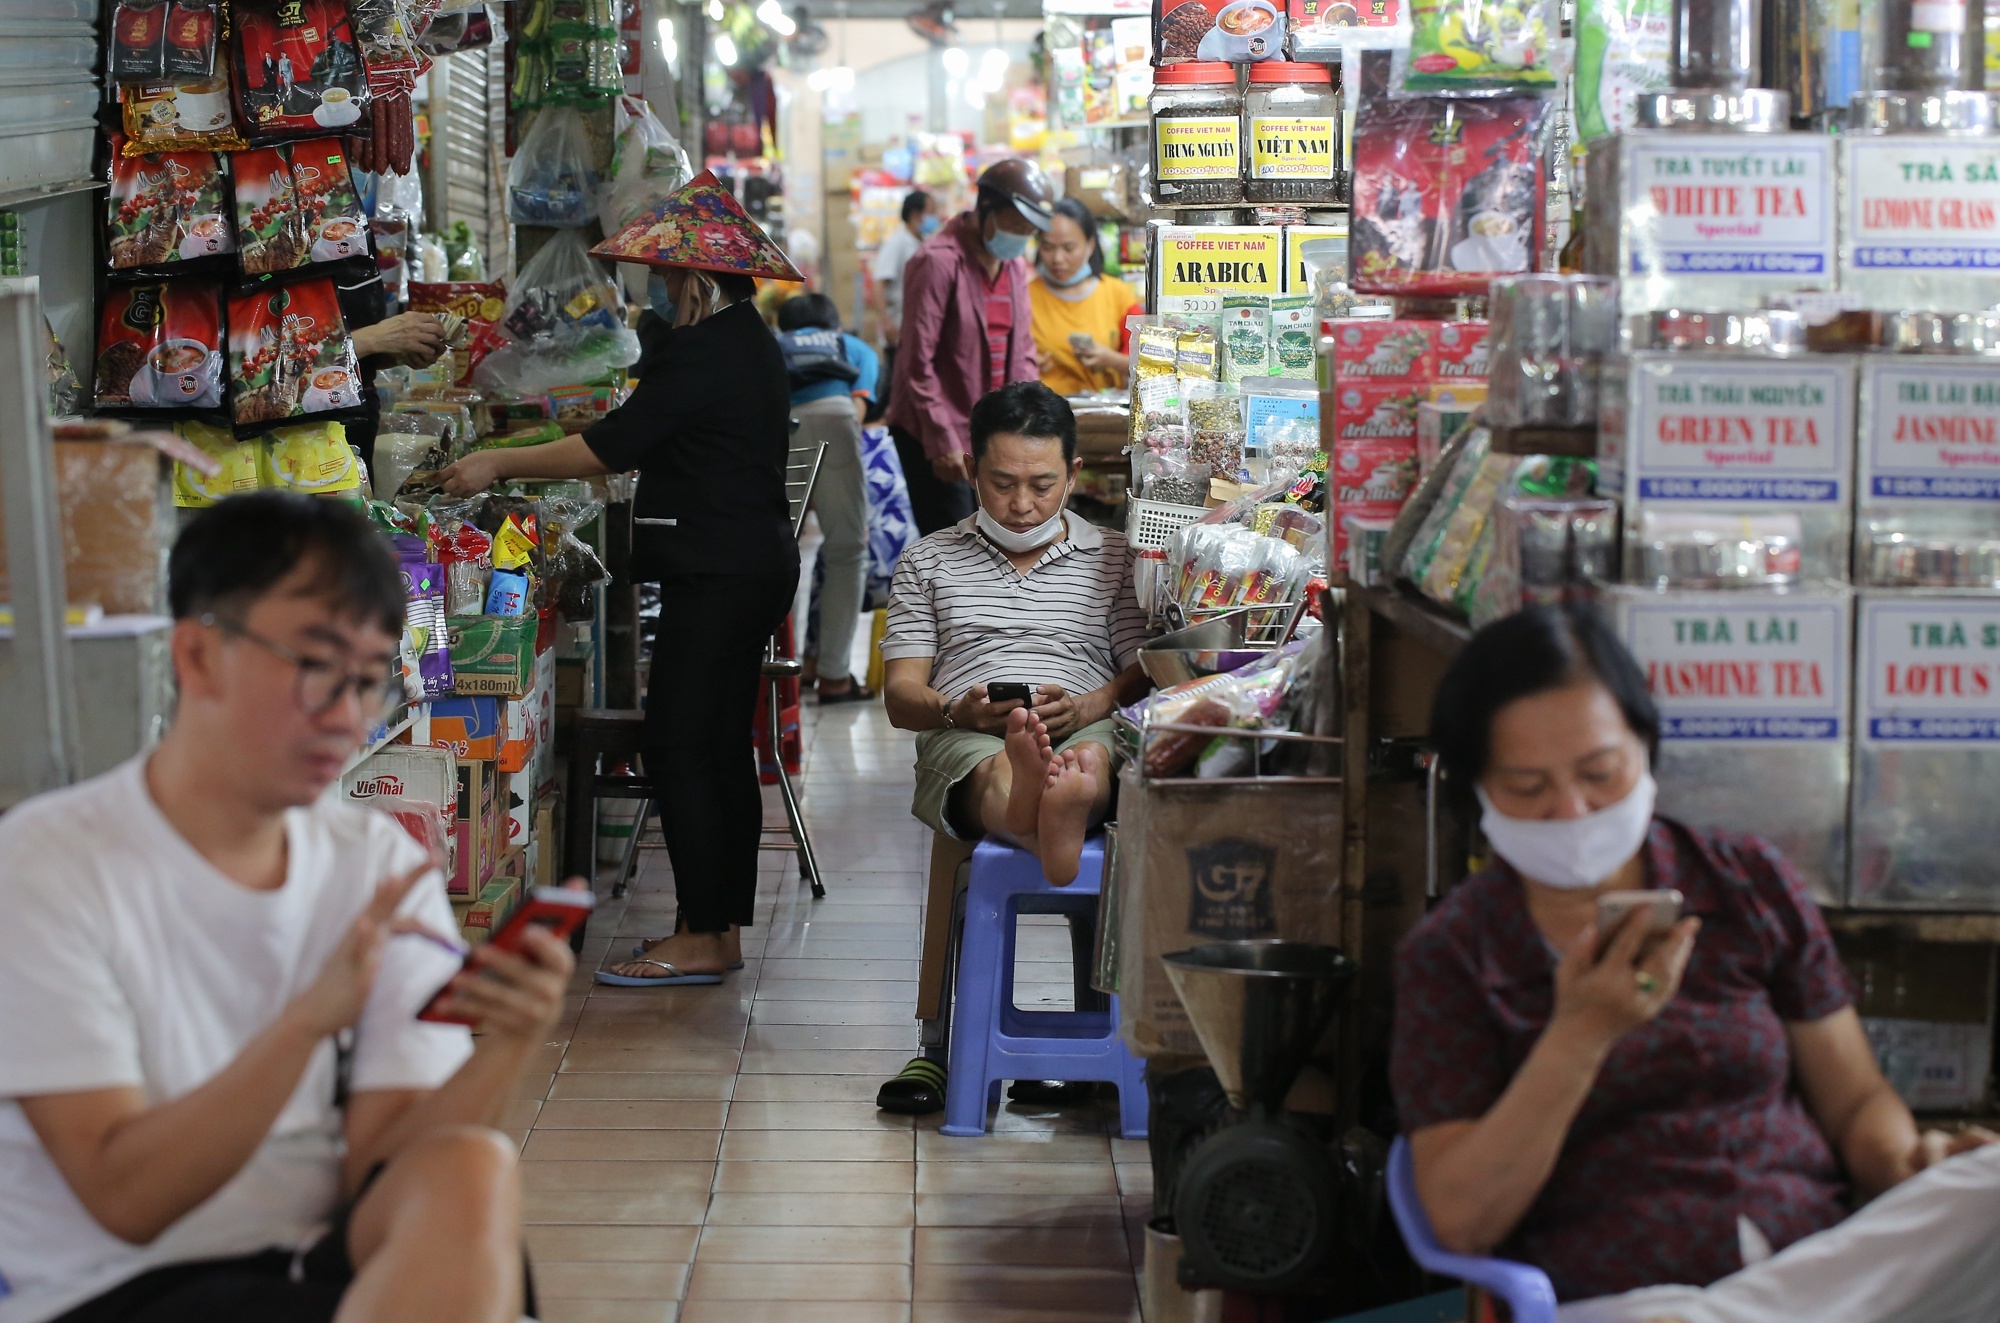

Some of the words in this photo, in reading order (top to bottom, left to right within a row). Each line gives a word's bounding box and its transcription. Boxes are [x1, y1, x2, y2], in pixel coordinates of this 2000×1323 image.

[1163, 143, 1195, 158] TRUNG
[1198, 138, 1234, 157] NGUYÊN
[1257, 135, 1293, 158] VIỆT
[1297, 139, 1328, 154] NAM
[1654, 156, 1692, 176] TRÀ
[1900, 158, 1954, 182] TRÀ
[1650, 185, 1743, 217] WHITE
[1753, 186, 1808, 217] TEA
[1938, 198, 1996, 229] GRASS
[1176, 241, 1215, 250] COFFEE
[1218, 241, 1241, 250] VIET
[1243, 241, 1266, 250] NAM
[1172, 262, 1268, 283] ARABICA
[1658, 415, 1754, 444] GREEN
[1762, 416, 1820, 446] TEA
[1893, 415, 1999, 443] JASMINE
[1672, 618, 1733, 644] TRÀ
[1982, 621, 2000, 648] S
[1645, 660, 1762, 697] JASMINE
[1772, 660, 1824, 697] TEA
[1884, 662, 1990, 698] LOTUS
[1196, 862, 1266, 901] G7
